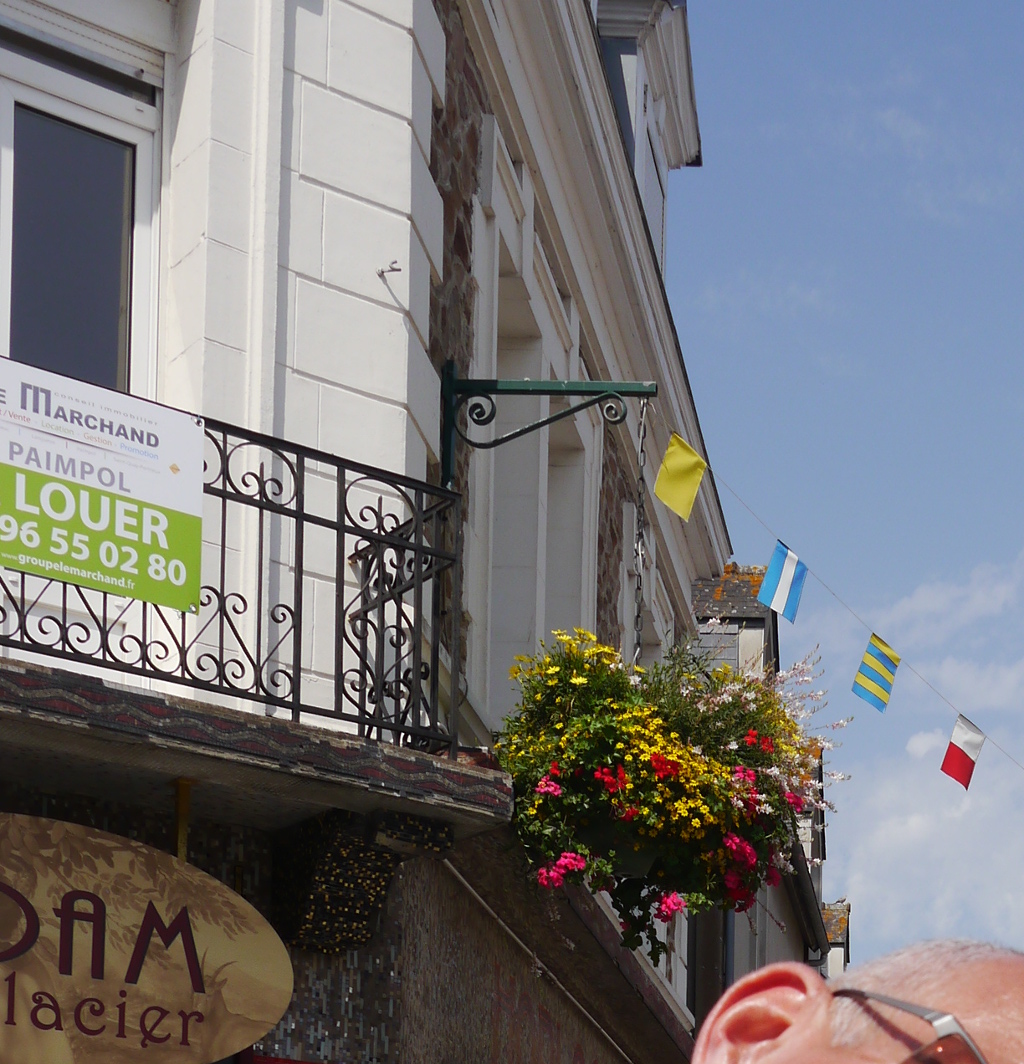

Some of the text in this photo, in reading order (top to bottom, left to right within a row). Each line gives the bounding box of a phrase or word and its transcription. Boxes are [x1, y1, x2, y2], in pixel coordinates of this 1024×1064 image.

[20, 381, 160, 449] MARCHAND
[41, 419, 75, 436] Location
[83, 431, 113, 447] Gestion
[120, 442, 159, 461] Promotion
[54, 391, 158, 426] conseil immobilier
[8, 440, 131, 494] PAIMPOL
[15, 472, 169, 550] LOUER
[0, 514, 187, 587] 96 55 02 80
[4, 970, 205, 1049] lacier
